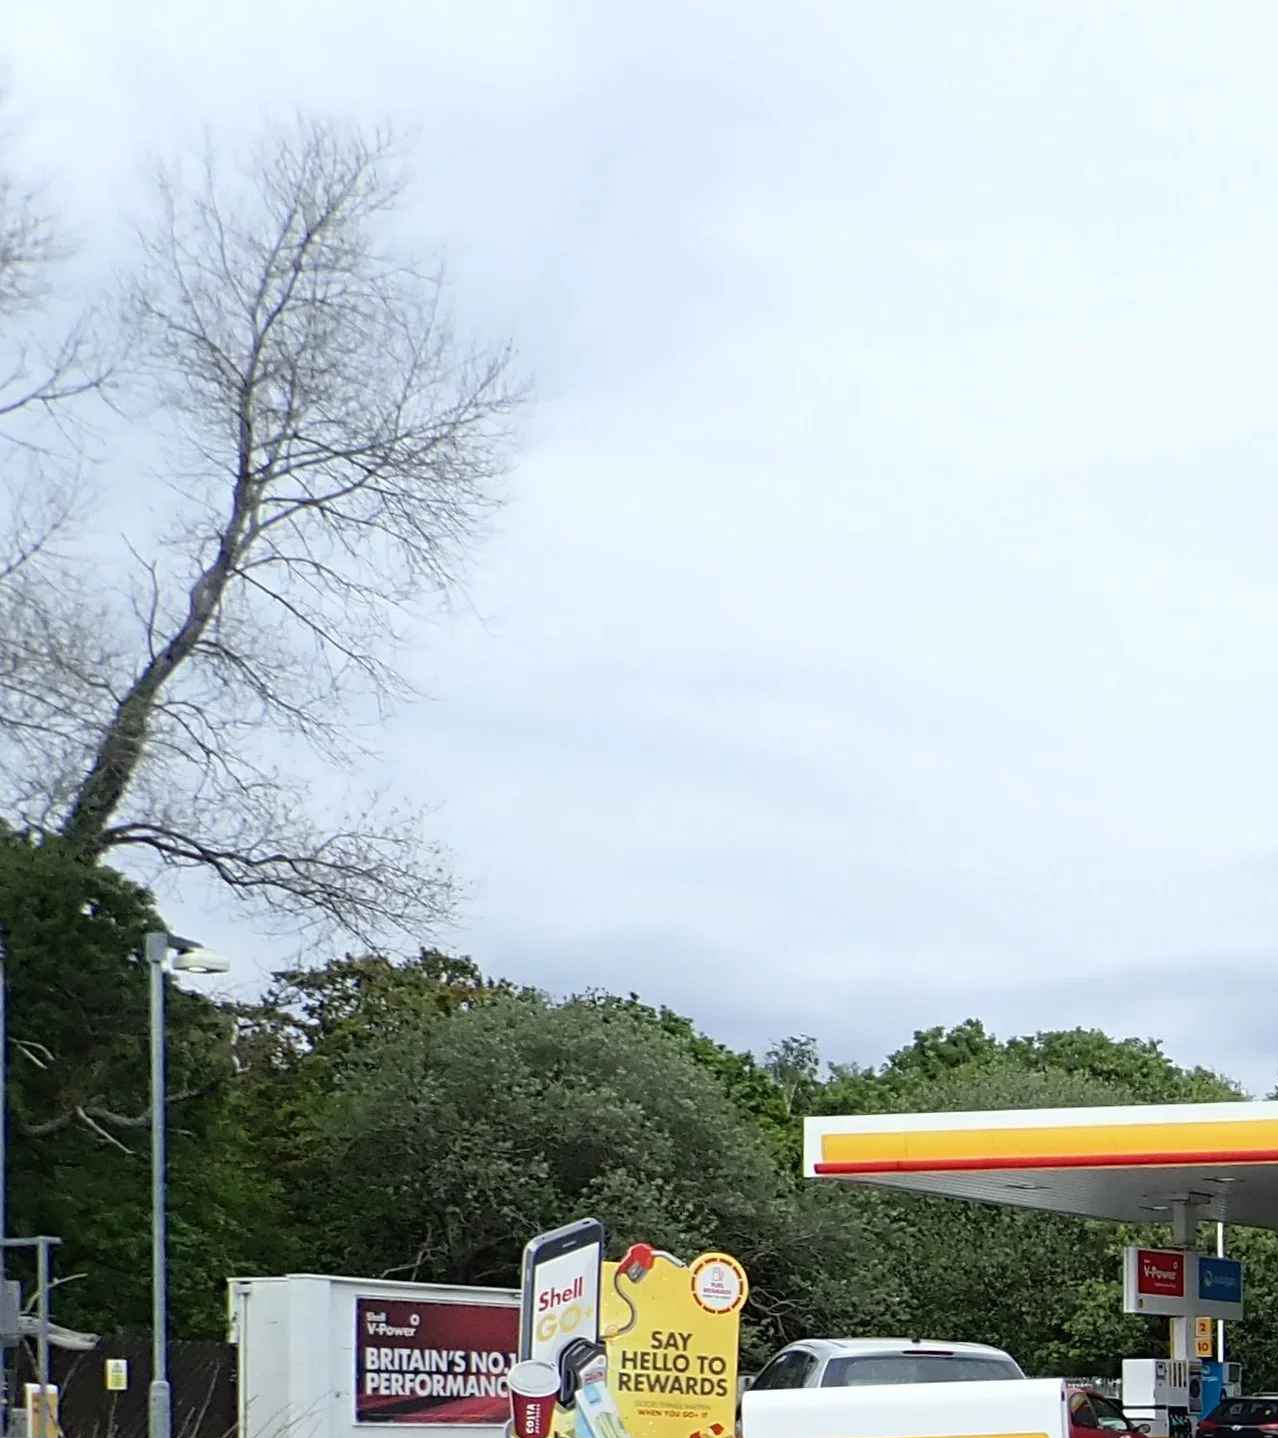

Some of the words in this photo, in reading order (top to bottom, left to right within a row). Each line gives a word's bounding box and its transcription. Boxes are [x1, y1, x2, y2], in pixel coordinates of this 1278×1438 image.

[538, 1276, 583, 1312] Shell
[367, 1323, 416, 1337] V-Power
[1200, 1323, 1206, 1332] 2
[651, 1331, 692, 1351] SAY
[1198, 1343, 1209, 1353] 10
[365, 1348, 466, 1372] BRITAIN'S
[621, 1351, 689, 1373] HELLO
[697, 1356, 726, 1375] TO
[366, 1372, 509, 1397] PERFORMANC
[618, 1373, 727, 1397] REWARDS
